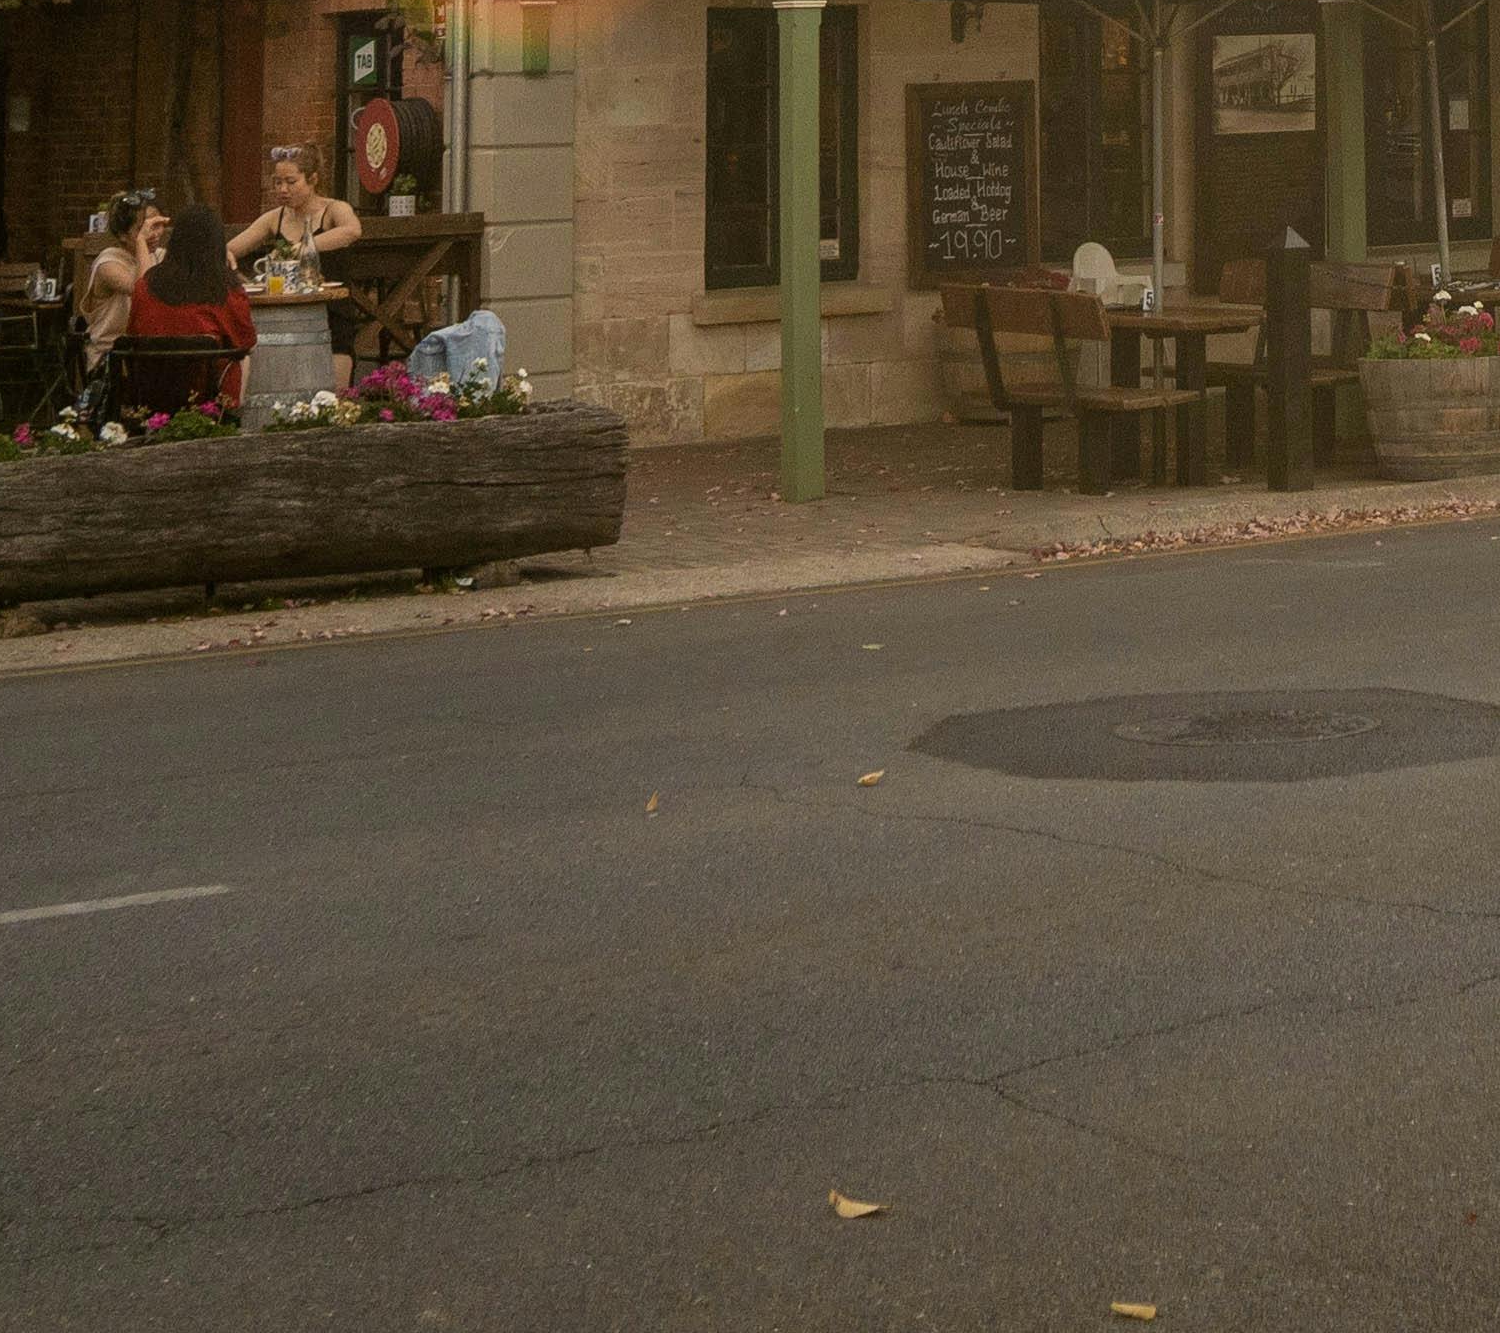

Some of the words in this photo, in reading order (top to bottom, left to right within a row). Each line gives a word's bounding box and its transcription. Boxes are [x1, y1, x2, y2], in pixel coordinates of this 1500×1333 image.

[356, 54, 373, 70] TAB
[931, 99, 969, 117] Lunch
[986, 132, 1013, 149] Salad
[970, 148, 980, 165] &
[935, 162, 970, 178] House
[982, 162, 1009, 177] Wine
[933, 183, 971, 201] Loaded
[932, 209, 970, 225] German
[980, 204, 1008, 222] Beer
